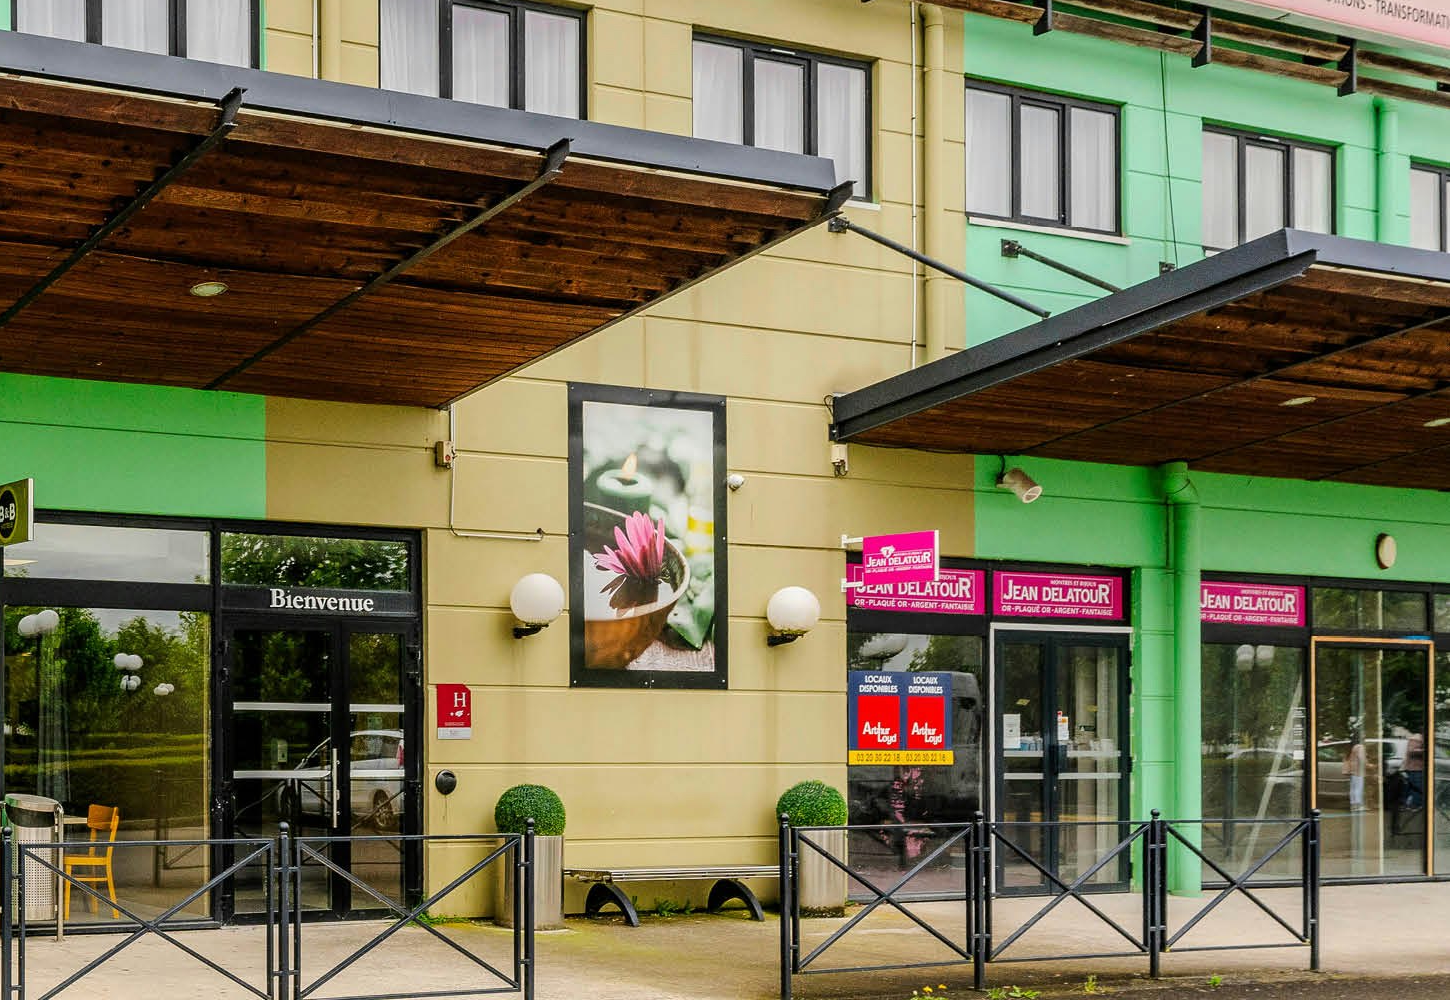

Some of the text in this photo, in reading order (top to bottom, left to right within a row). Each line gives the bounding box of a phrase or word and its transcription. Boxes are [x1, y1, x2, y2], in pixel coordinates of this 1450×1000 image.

[866, 556, 887, 568] JEAN
[889, 551, 931, 564] DELATOUR
[897, 577, 971, 598] DELATOUR
[1003, 579, 1110, 604] JEAN DELATOUR
[269, 588, 374, 612] Bienvenue
[1233, 593, 1296, 613] DELATOUR
[864, 675, 892, 684] LOCAUX
[912, 676, 938, 685] LOCAUX
[859, 684, 898, 693] DISPONIBLES
[908, 685, 943, 694] DISPONIBLES
[453, 692, 467, 707] H
[862, 721, 890, 735] Arthur
[911, 722, 937, 735] Arthur
[877, 733, 897, 745] Loyd
[924, 734, 943, 745] Loyd
